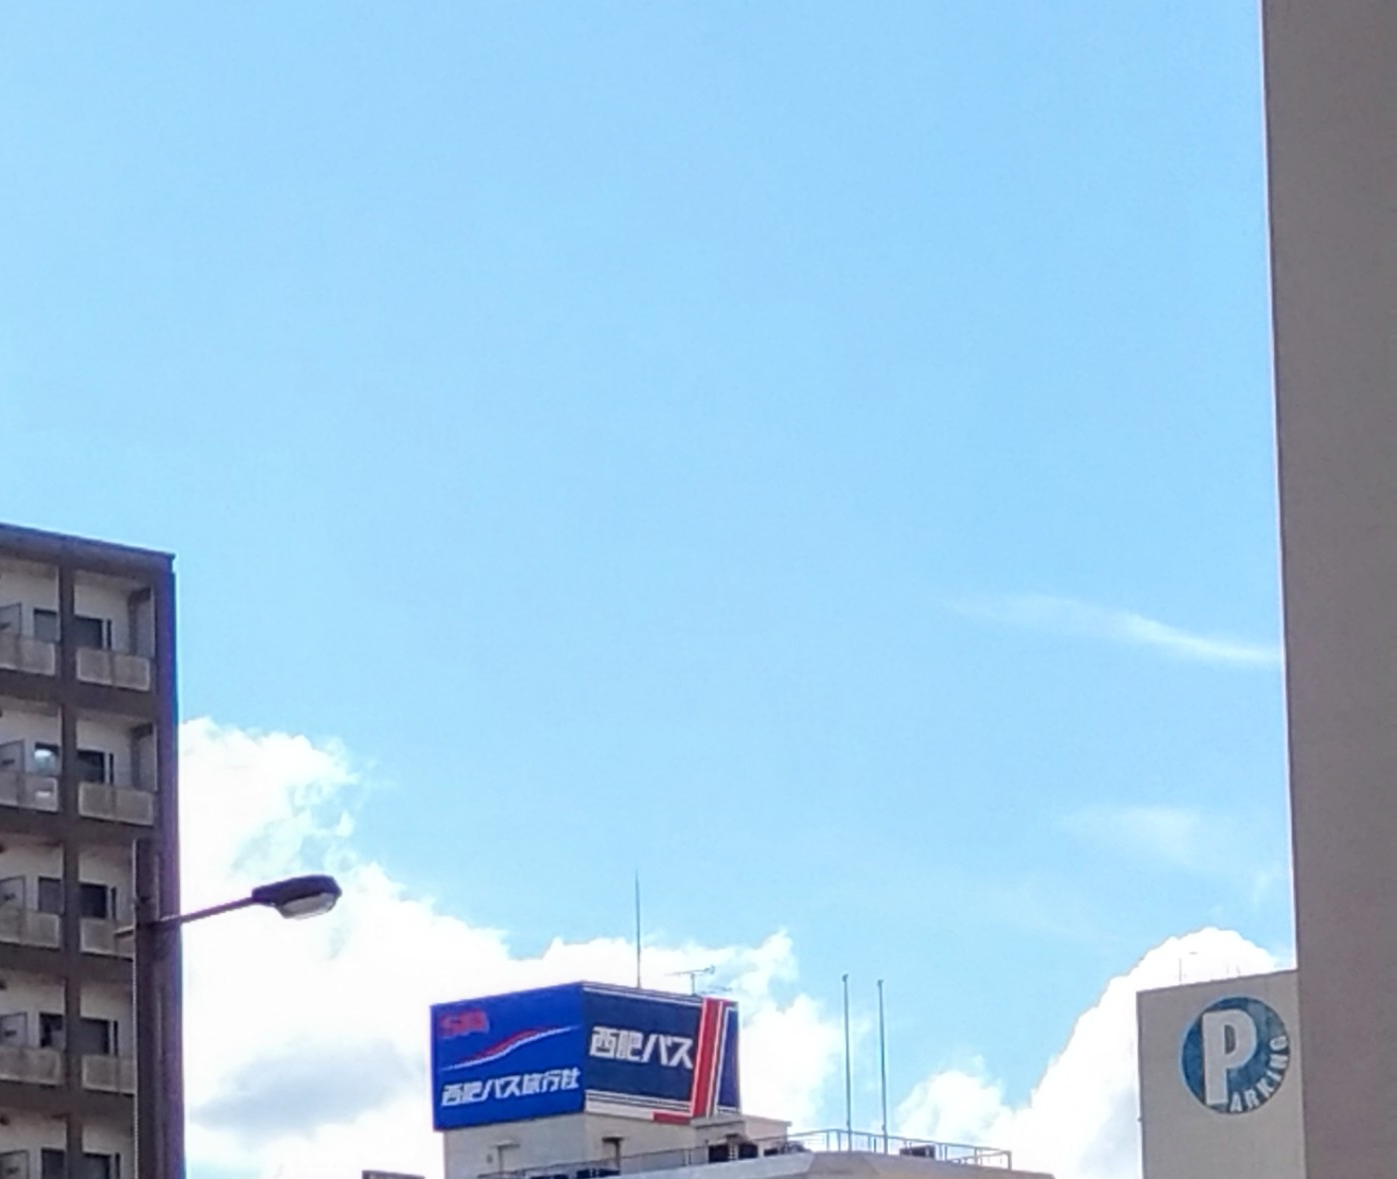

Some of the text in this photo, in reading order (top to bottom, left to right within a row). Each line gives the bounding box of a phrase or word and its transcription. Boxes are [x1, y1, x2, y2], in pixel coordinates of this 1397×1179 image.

[590, 1026, 694, 1070] 西肥バス
[440, 1066, 582, 1107] 西肥バス旅行社
